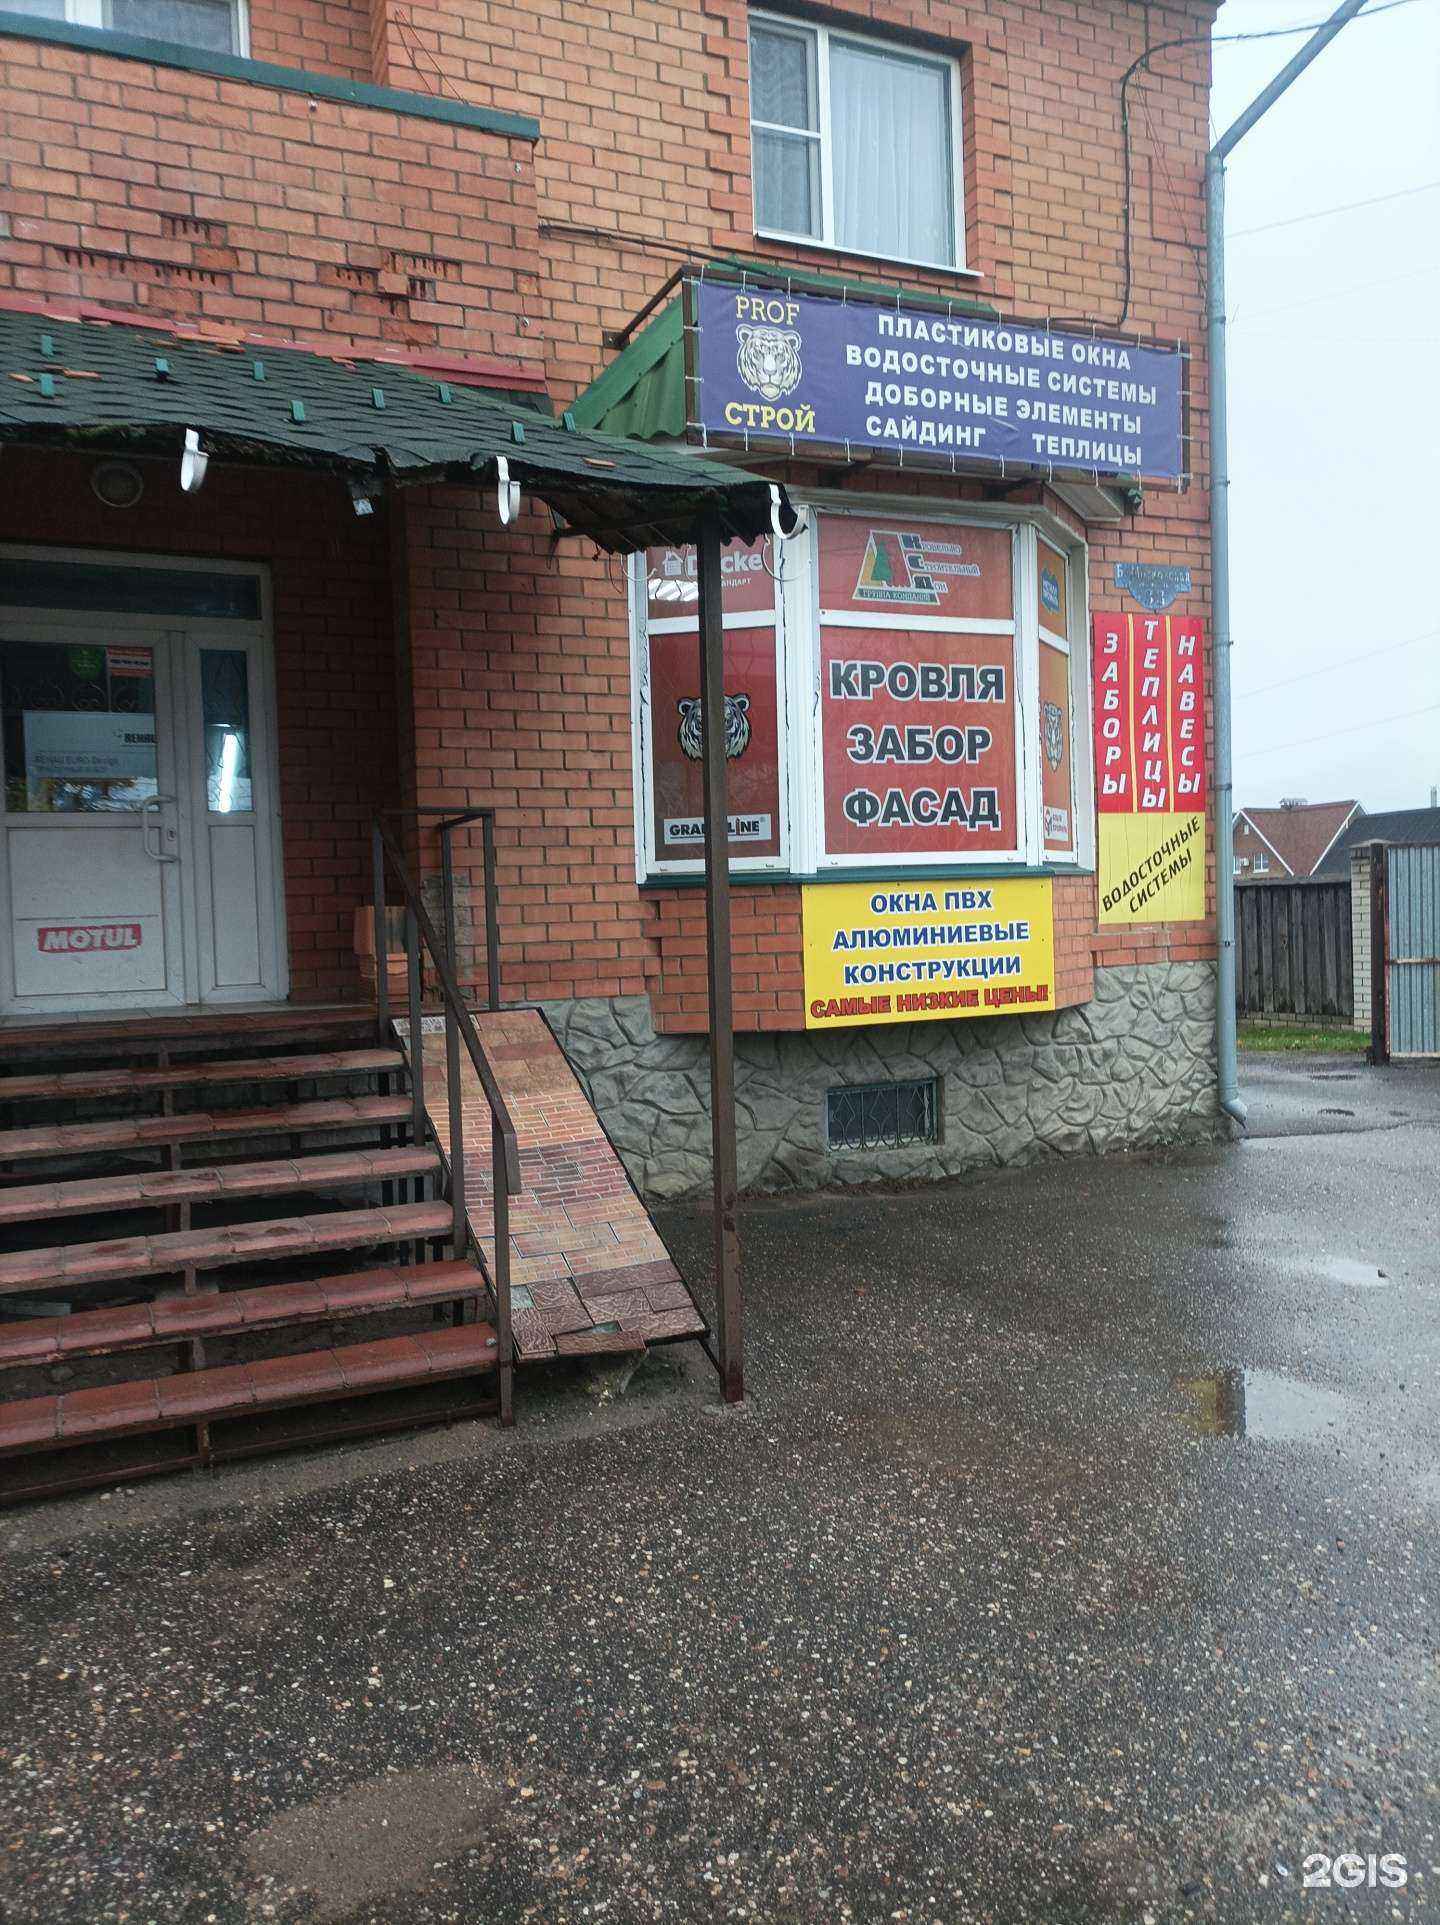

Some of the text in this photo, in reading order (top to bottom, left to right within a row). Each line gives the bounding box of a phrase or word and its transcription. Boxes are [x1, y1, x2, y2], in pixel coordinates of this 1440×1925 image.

[736, 294, 800, 325] PROF
[878, 314, 1131, 371] ПЛАСТИКОВЫЕ ОКНА
[846, 344, 1157, 406] ВОДОСТОЧНЫЕ СИСТЕМЫ
[725, 402, 816, 433] СТРОЙ
[865, 381, 1141, 434] ДОБОРНЫЕ ЭЛЕМЕНТЫ
[866, 415, 1142, 466] САЙДИНГ ТЕПЛИЦЫ
[687, 551, 763, 576] Dcke
[829, 660, 1006, 703] КРОВЛЯ
[1101, 632, 1127, 794] ЗАБОРЫ
[1141, 620, 1166, 808] ТЕПЛИЦЫ
[1177, 634, 1201, 794] НАВЕСЫ
[847, 724, 993, 765] ЗАБОР
[843, 787, 1002, 832] ФАСАД
[1102, 816, 1200, 913] ВОДОСТОЧНЫЕ
[1129, 848, 1193, 914] СИСТЕМЫ
[870, 889, 993, 914] ОКНА ПВХ
[42, 926, 139, 950] MOTUL
[832, 922, 1030, 951] АЛЮМИНИЕВЫЕ
[844, 955, 1022, 985] КОНСТРУКЦИИ
[810, 995, 891, 1018] САМЫЕ
[896, 989, 979, 1012] НИЗКИЕ
